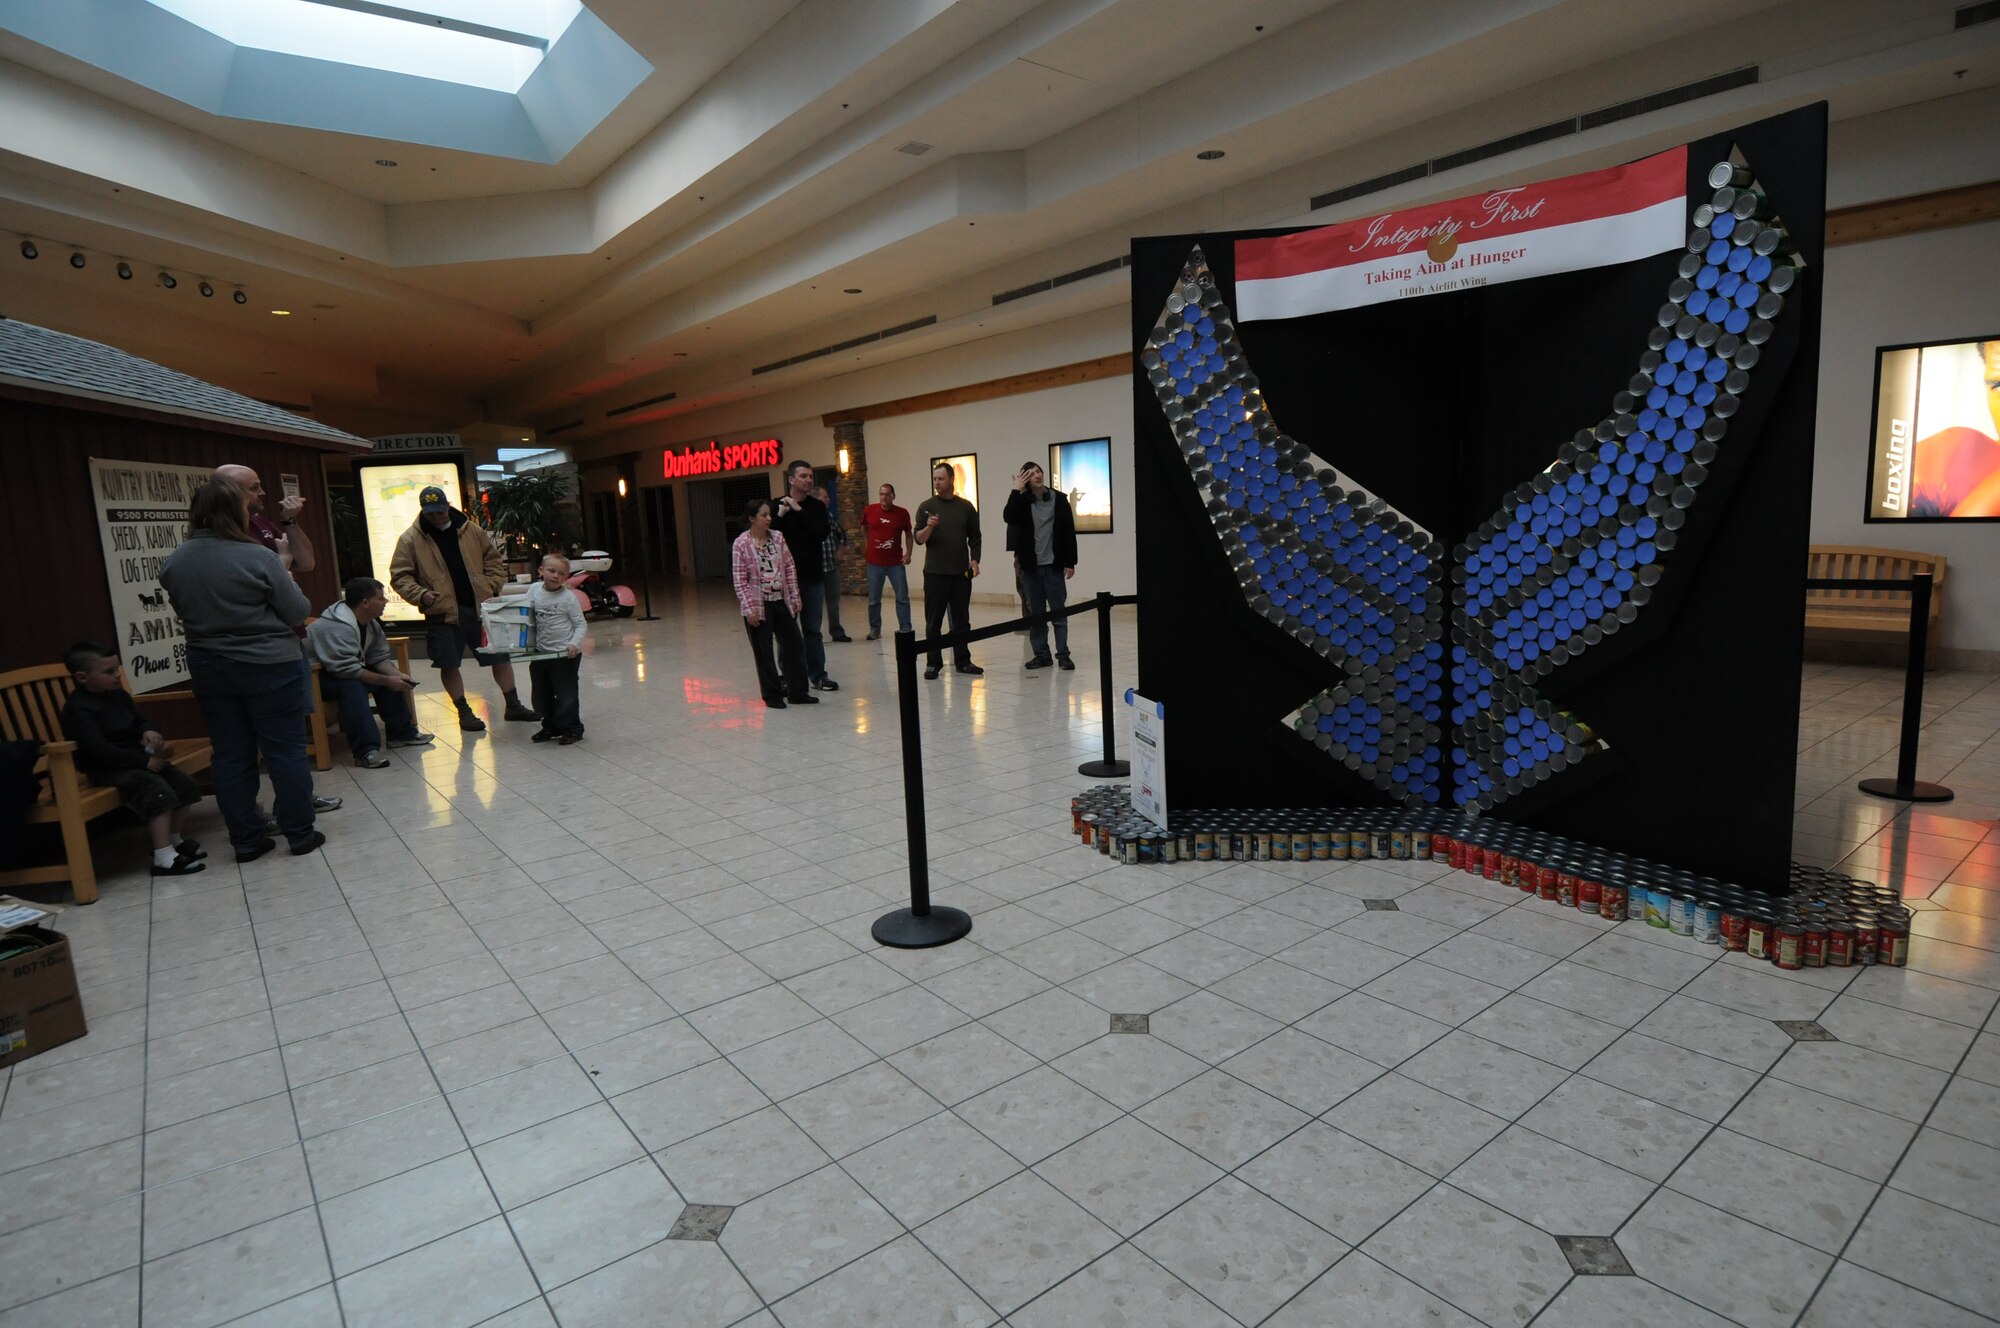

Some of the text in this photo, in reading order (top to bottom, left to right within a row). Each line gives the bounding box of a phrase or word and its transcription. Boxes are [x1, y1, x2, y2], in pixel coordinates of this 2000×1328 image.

[1349, 186, 1546, 253] Integrity First
[1364, 247, 1527, 285] Taking Aim at Hunger
[1399, 277, 1488, 297] 110th Airlift Wing
[373, 436, 456, 450] IRECTORY
[663, 439, 779, 479] Dunham's SPORTS
[1882, 418, 1908, 512] boxing
[98, 468, 145, 501] KUNTRY
[116, 511, 142, 520] 9500
[110, 525, 145, 553] SHEDS,
[119, 557, 141, 584] LOG
[128, 615, 186, 646] AMIS
[172, 643, 188, 659] 88
[131, 655, 172, 678] Phone
